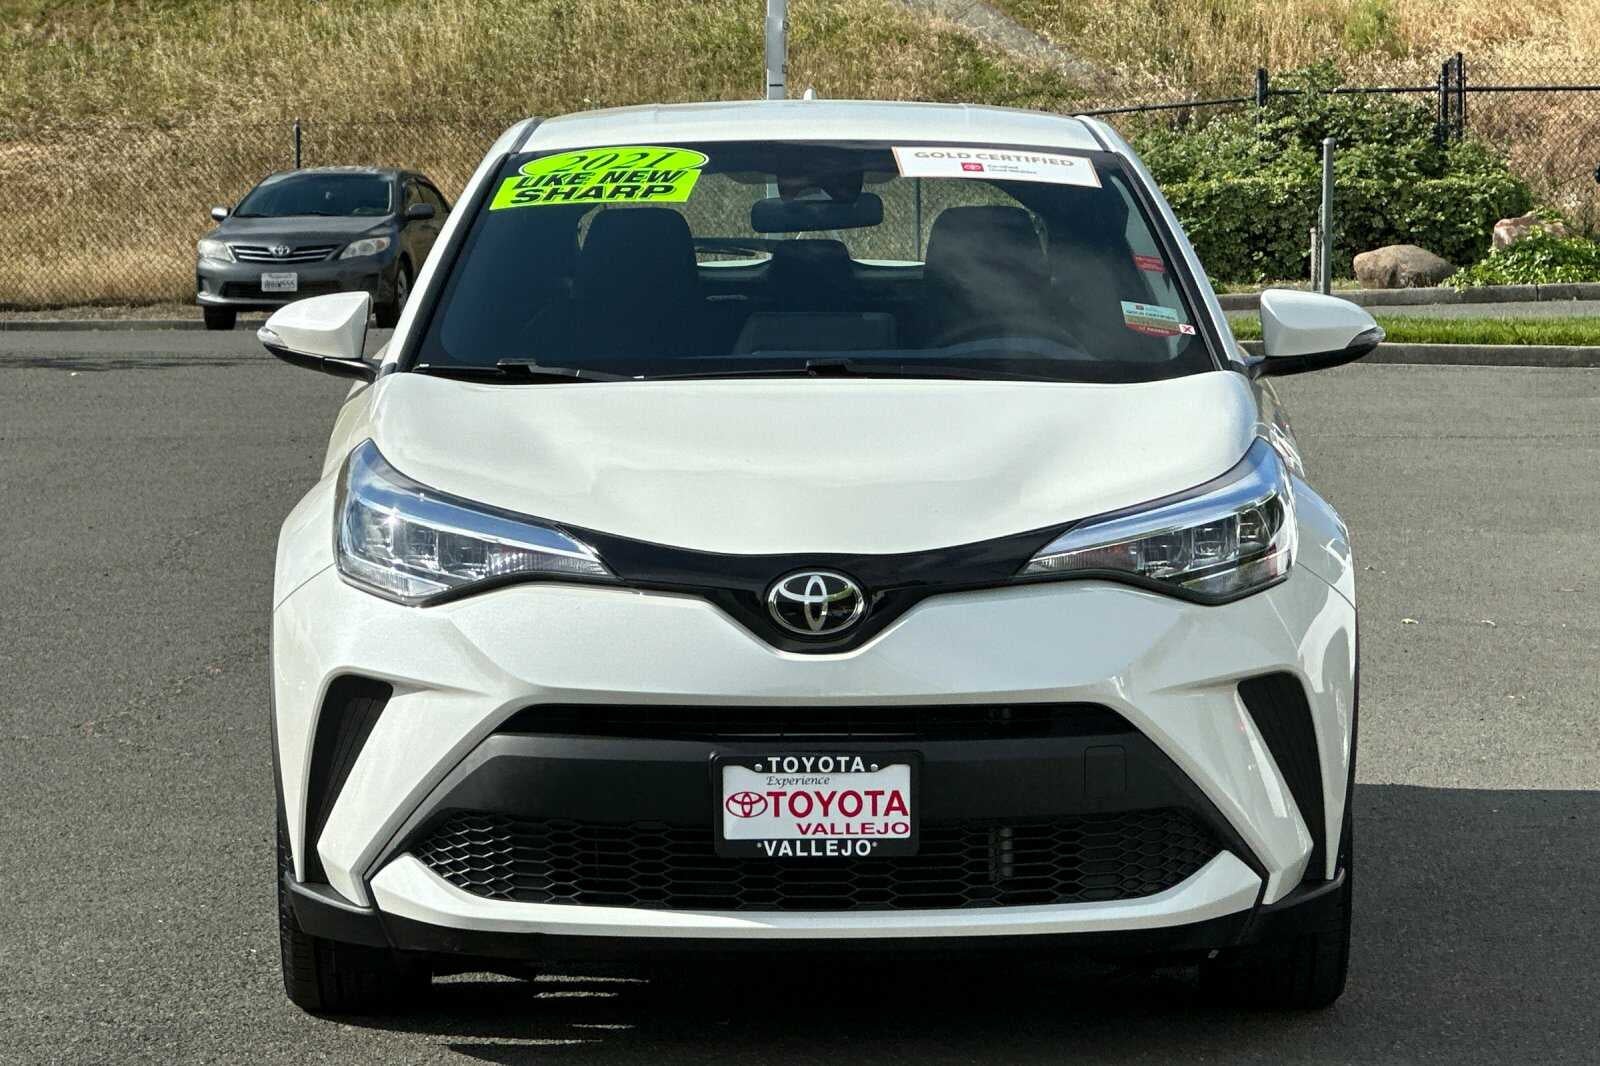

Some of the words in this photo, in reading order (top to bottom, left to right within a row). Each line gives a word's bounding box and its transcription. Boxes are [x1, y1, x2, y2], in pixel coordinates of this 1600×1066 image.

[551, 151, 677, 173] 2021
[914, 151, 970, 160] GOLD
[975, 153, 1075, 167] CERTIFIED
[512, 171, 594, 190] LIKE
[600, 169, 689, 185] NEW
[510, 184, 677, 204] SHARP
[767, 756, 866, 773] TOYOTA
[766, 775, 831, 789] Experience
[766, 789, 909, 818] TOYOTA
[796, 822, 910, 835] VALLEJO
[763, 839, 872, 857] VALLEJO
